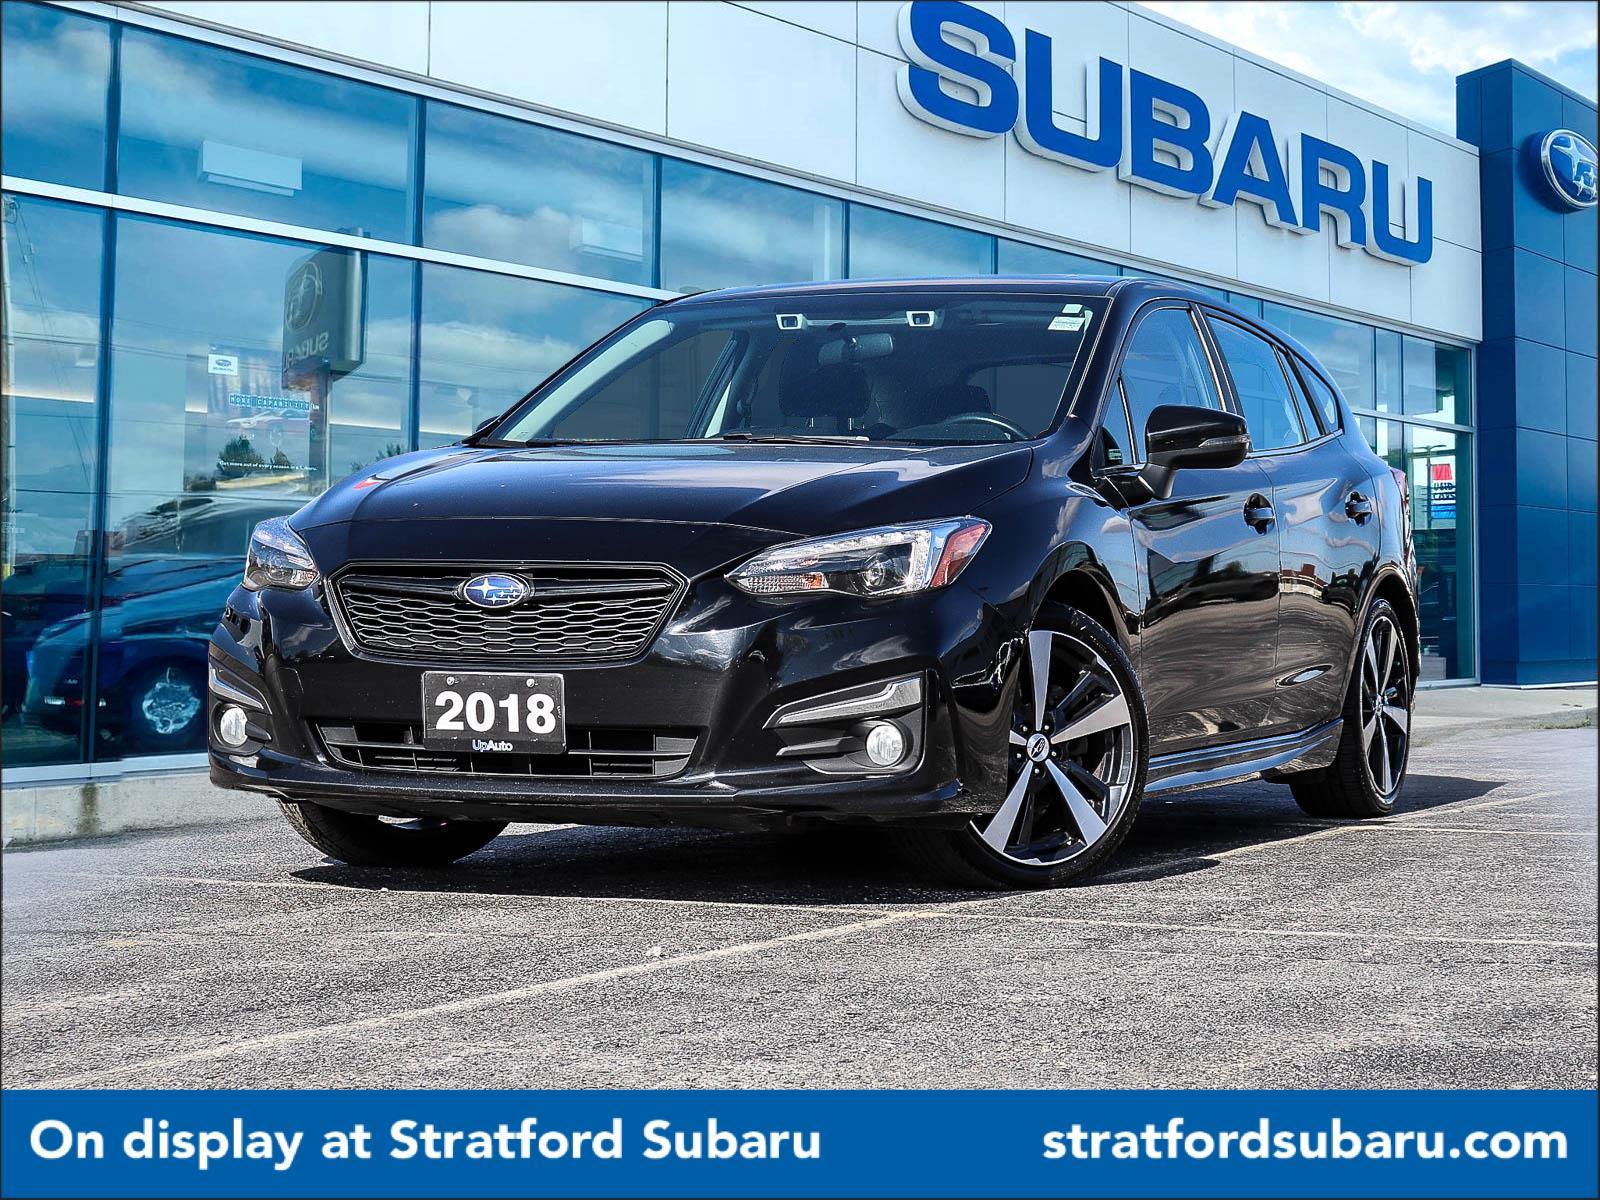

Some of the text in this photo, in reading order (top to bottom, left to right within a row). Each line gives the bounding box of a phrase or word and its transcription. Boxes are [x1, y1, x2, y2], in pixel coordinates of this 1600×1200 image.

[897, 1, 1433, 266] SUBARU
[434, 690, 556, 735] 2018
[472, 739, 514, 753] UpAuto
